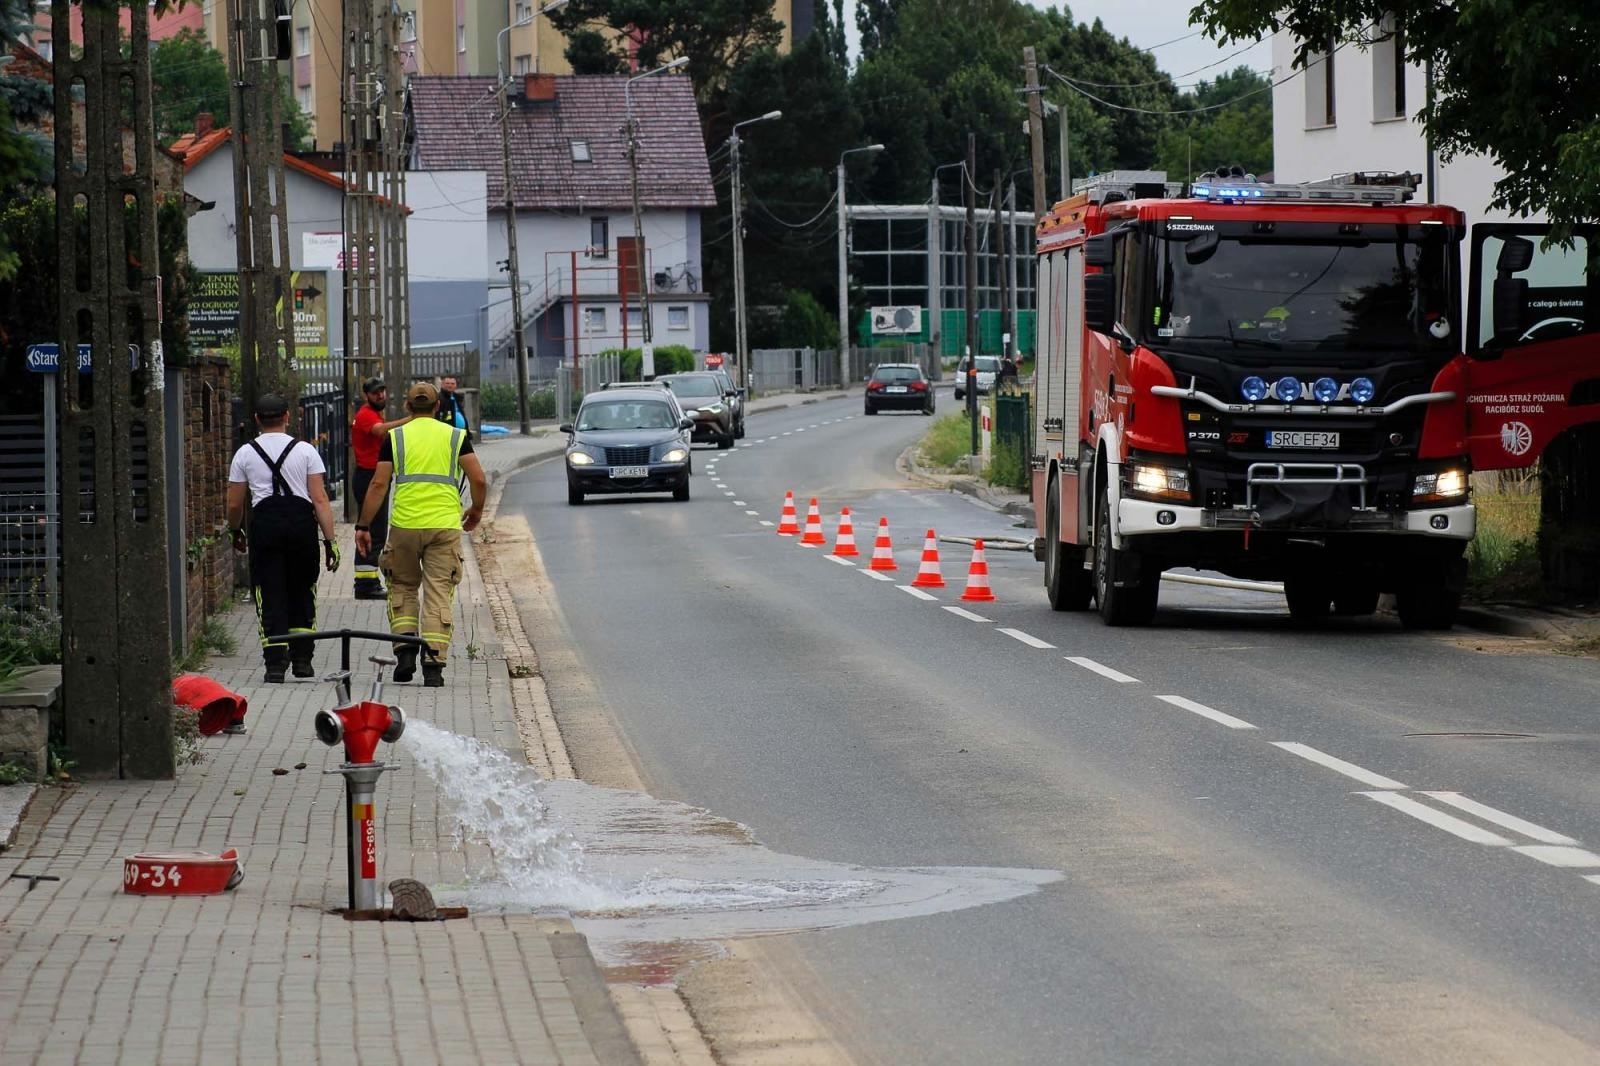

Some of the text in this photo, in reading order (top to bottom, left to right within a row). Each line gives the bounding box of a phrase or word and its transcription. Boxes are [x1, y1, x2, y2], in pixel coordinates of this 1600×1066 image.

[1172, 223, 1215, 231] SZCZĘŚNIAK
[1559, 299, 1584, 307] świata
[1509, 393, 1531, 402] STRAŻ
[1533, 392, 1565, 402] POŻARNA
[1485, 404, 1544, 414] RACIBÓRZ SUDÓŁ
[1189, 432, 1220, 440] P 370
[1274, 432, 1338, 446] SRC EF34
